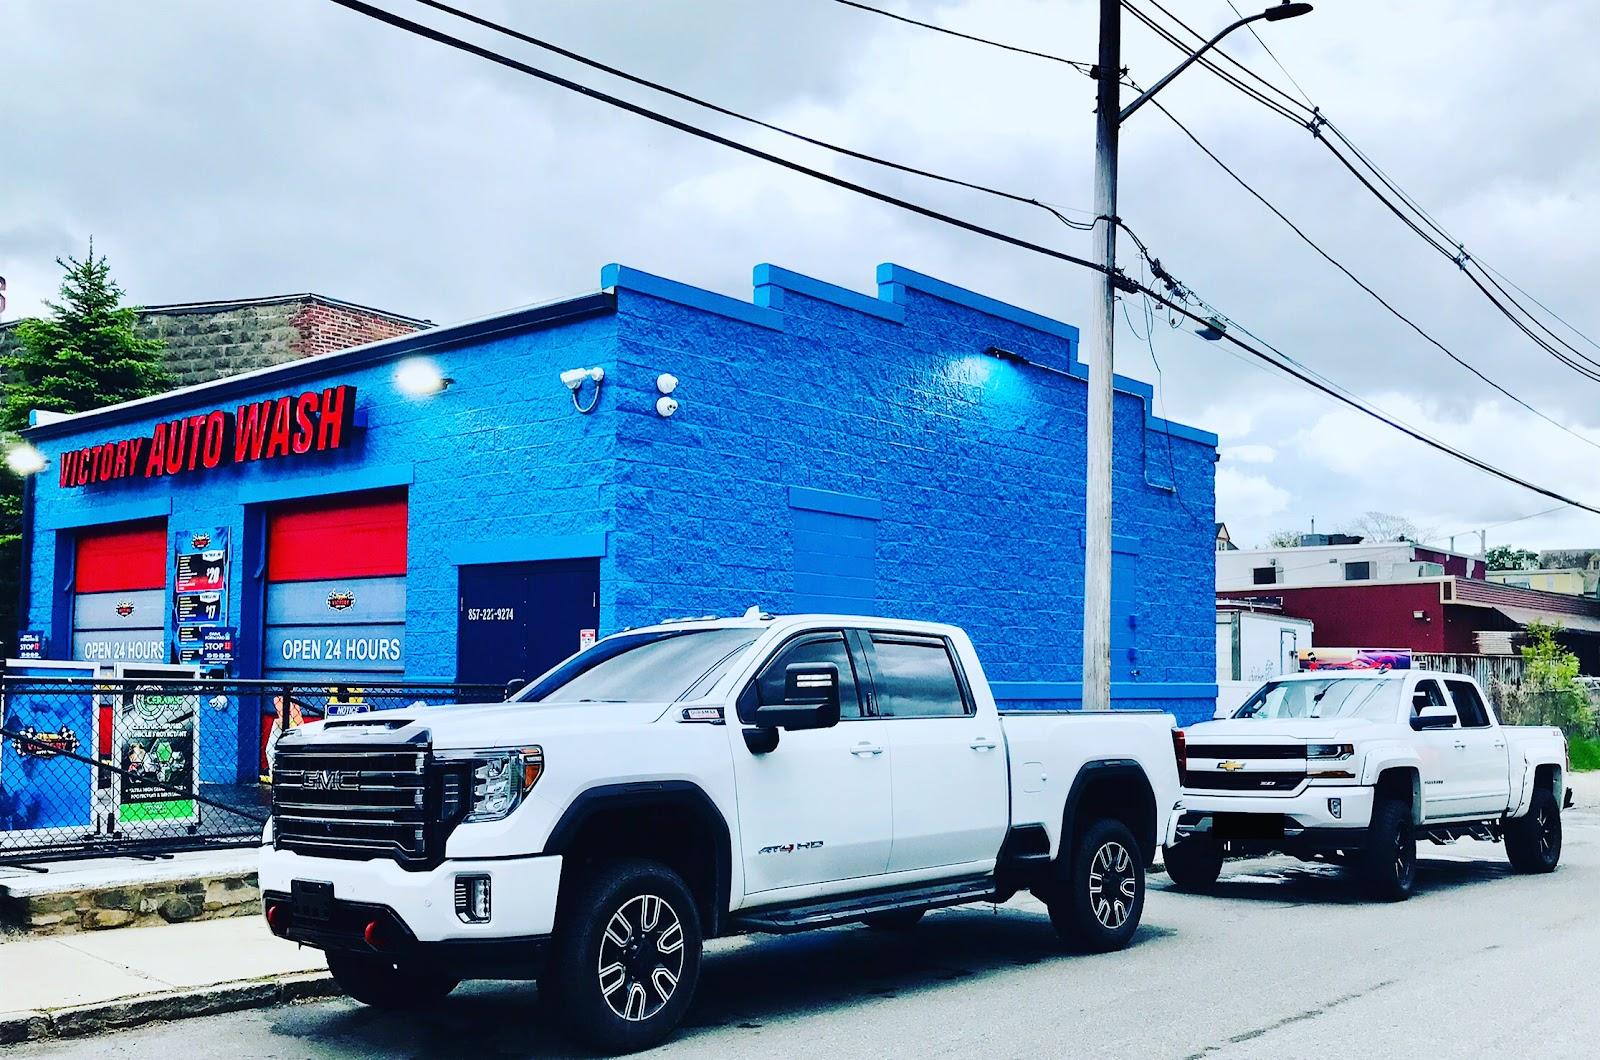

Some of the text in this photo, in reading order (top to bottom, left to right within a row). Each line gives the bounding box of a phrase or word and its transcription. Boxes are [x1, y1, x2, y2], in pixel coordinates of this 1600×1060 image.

[60, 385, 349, 488] VICTORY AUTO WASH
[85, 641, 111, 659] OPEN
[114, 641, 125, 659] 24
[128, 641, 164, 659] HOURS
[205, 642, 224, 650] STOP
[282, 638, 400, 660] OPEN 24 HOURS
[336, 706, 360, 715] NOTICE
[300, 770, 361, 790] GMC
[759, 841, 824, 854] AT4 HD
